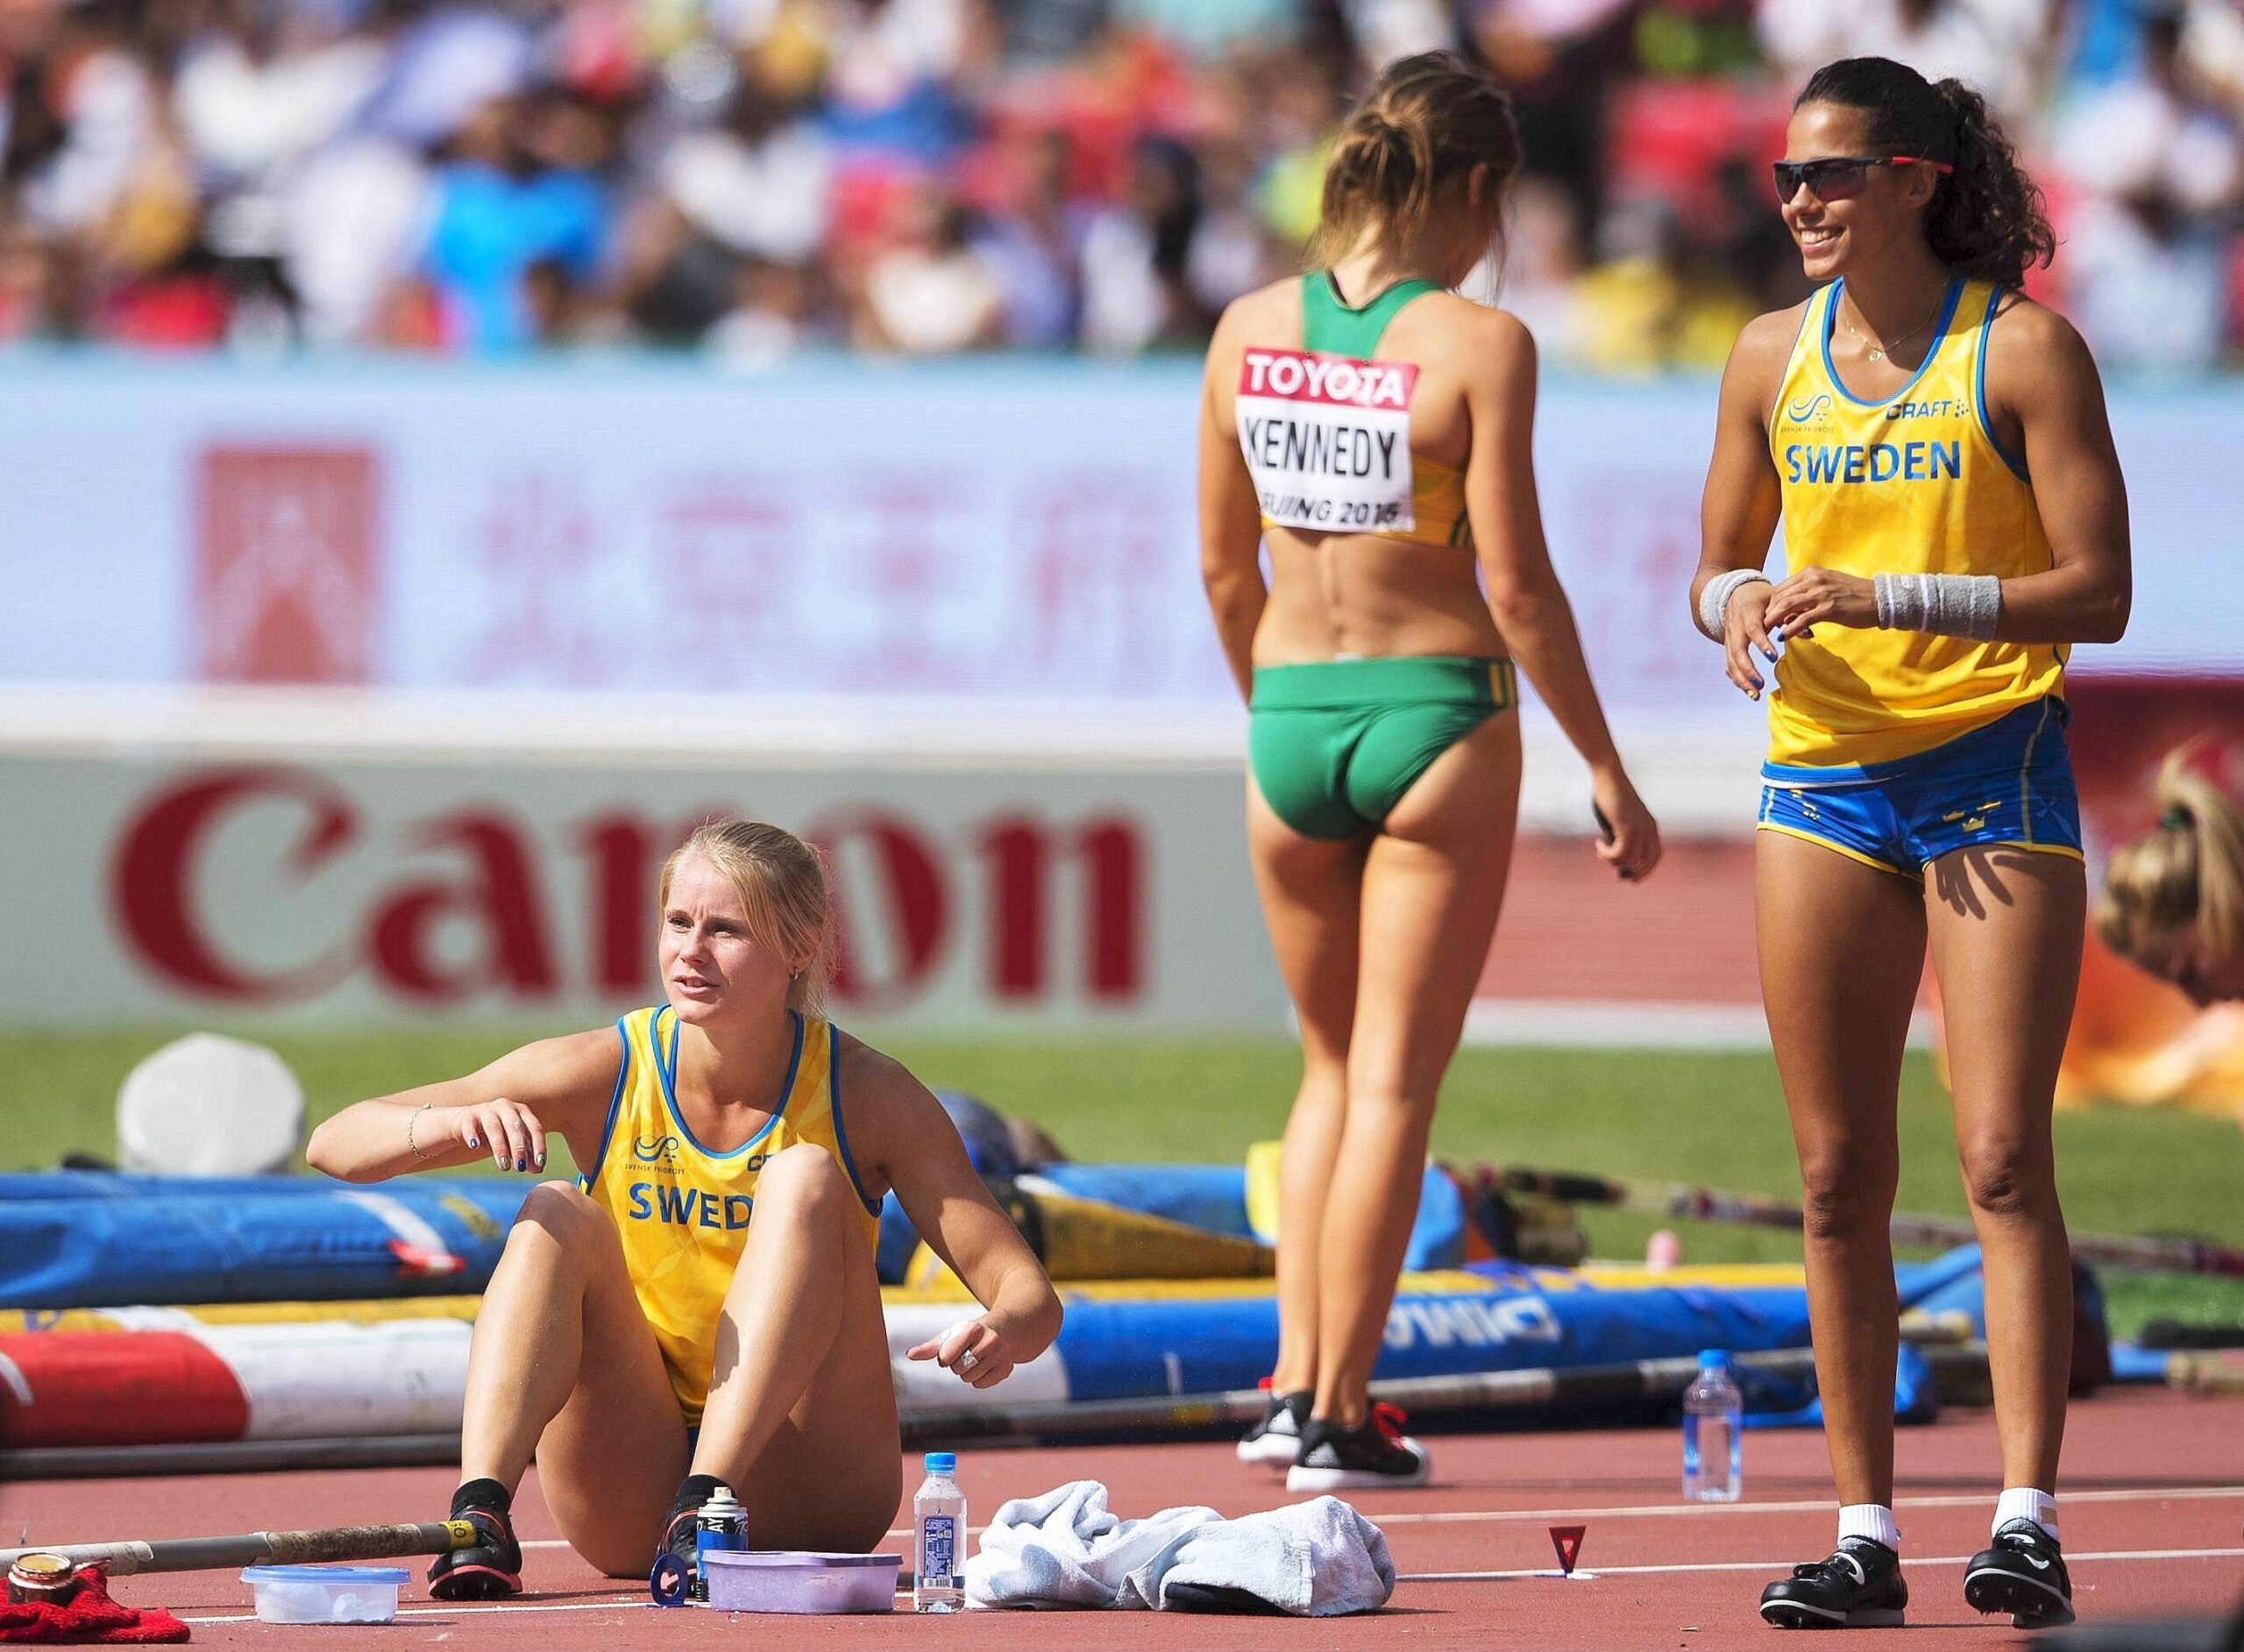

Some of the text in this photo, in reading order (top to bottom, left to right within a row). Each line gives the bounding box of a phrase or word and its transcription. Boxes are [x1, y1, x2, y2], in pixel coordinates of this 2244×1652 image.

[1246, 354, 1405, 406] TOYOTA
[1885, 401, 1952, 421] CRAFT
[1245, 417, 1395, 480] KENNEDY
[1786, 440, 1961, 483] SWEDEN
[111, 763, 1150, 1008] Canon
[629, 1182, 754, 1230] SWED
